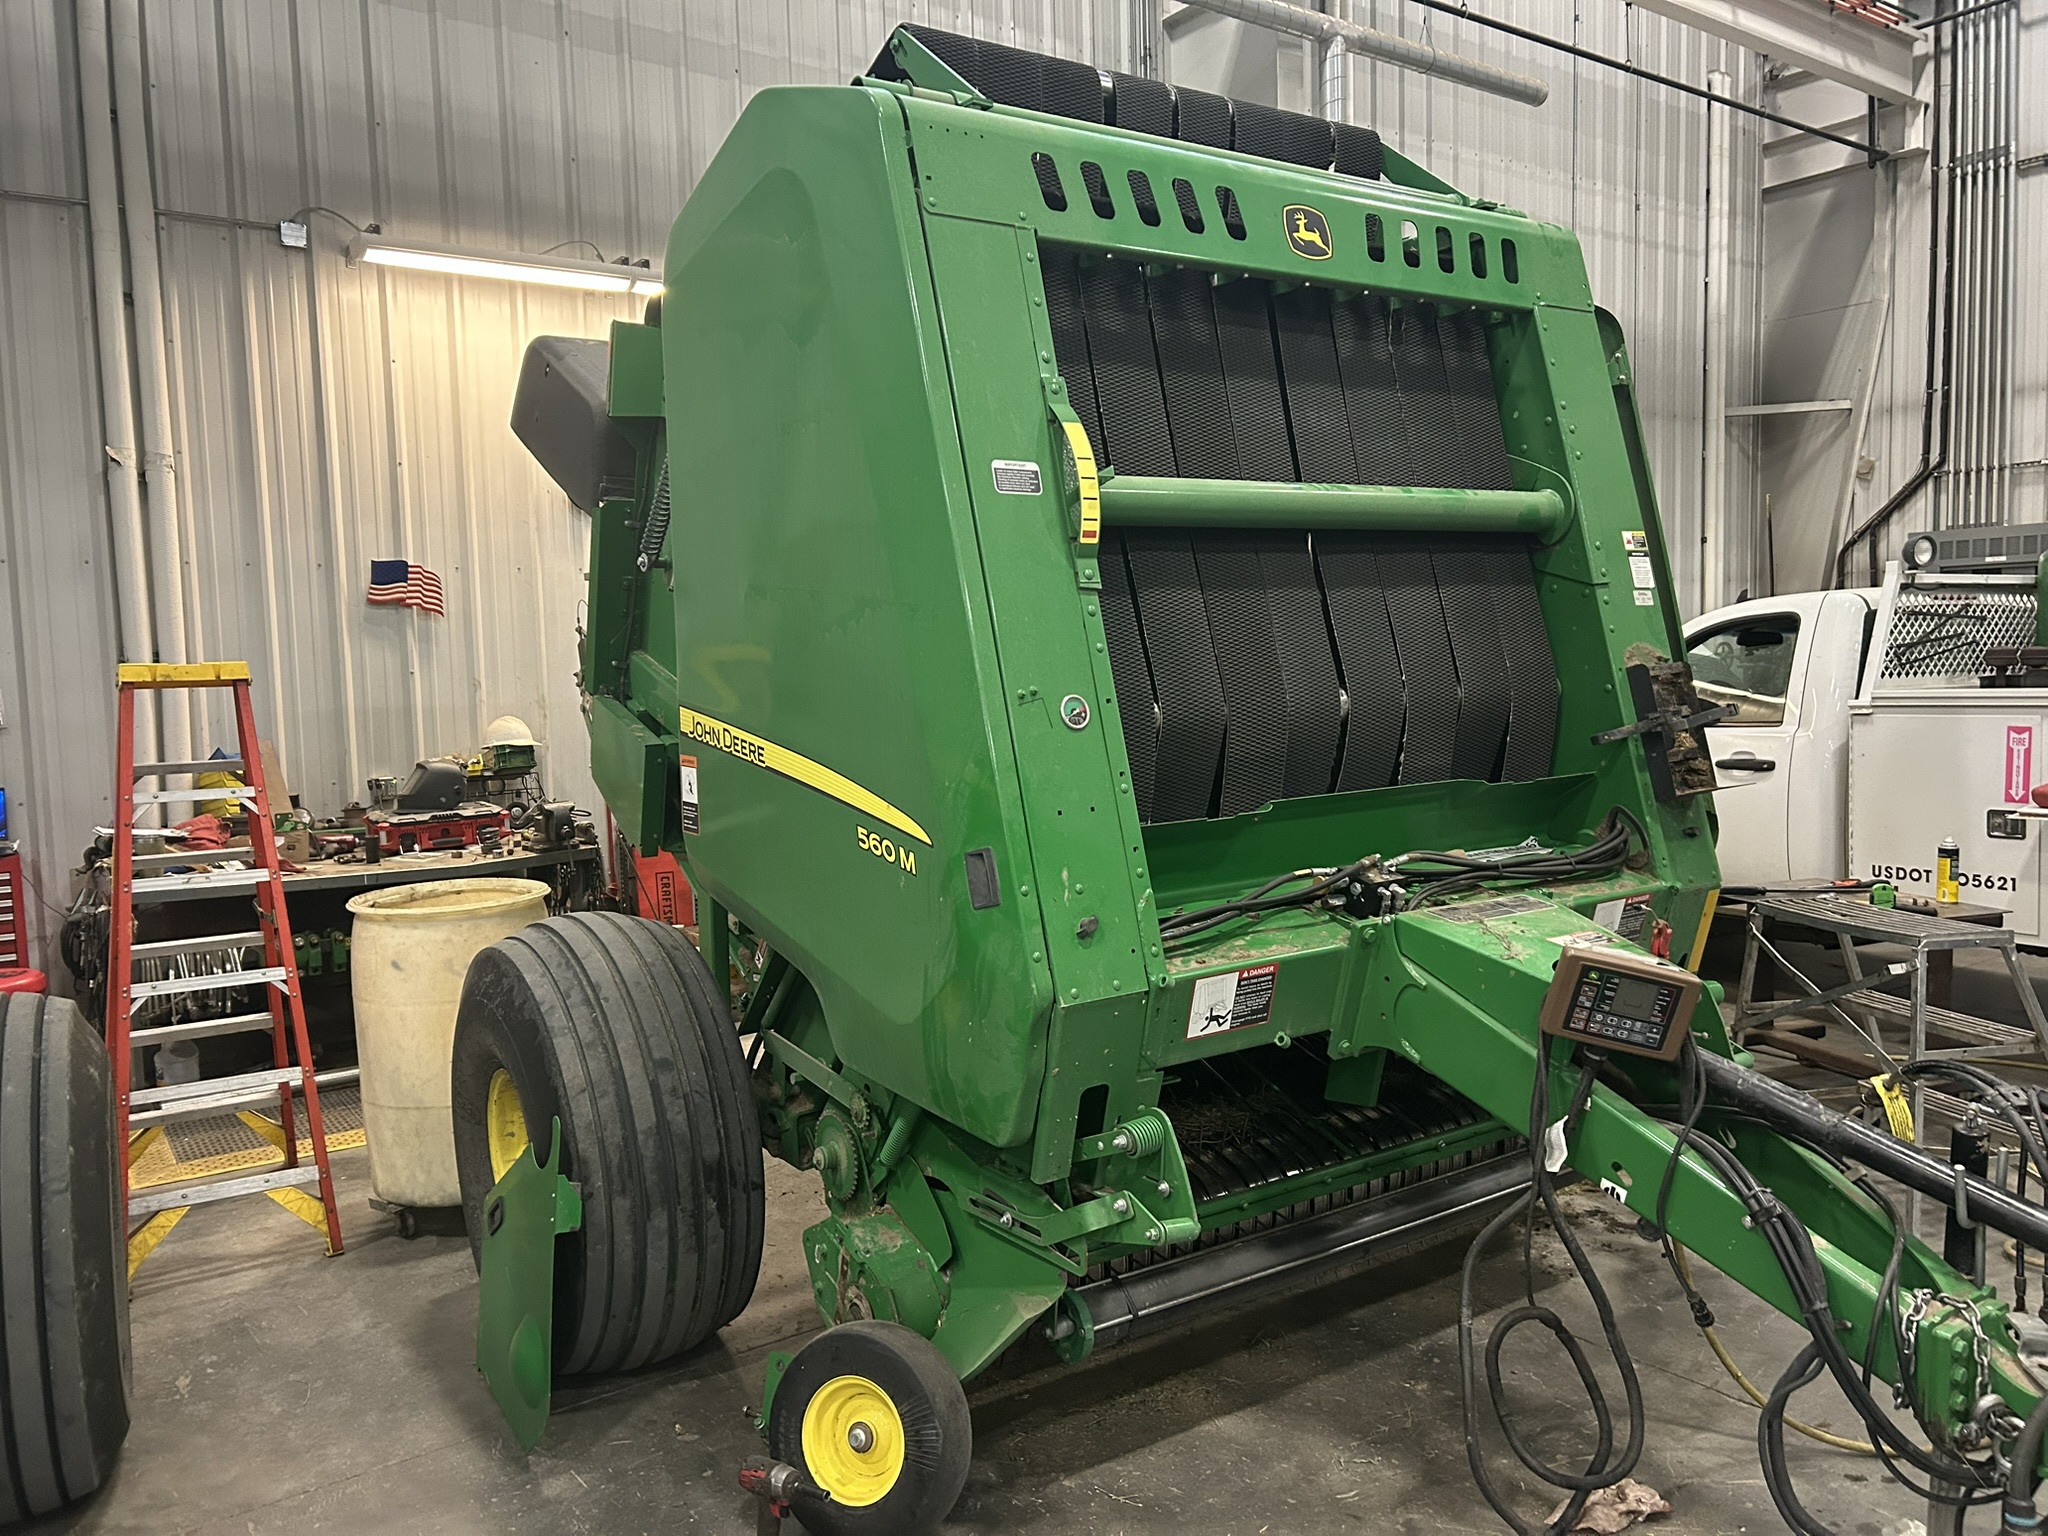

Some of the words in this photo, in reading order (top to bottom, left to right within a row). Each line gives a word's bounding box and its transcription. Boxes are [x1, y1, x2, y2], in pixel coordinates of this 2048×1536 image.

[689, 715, 720, 746] JOHN
[723, 727, 766, 764] DEERE
[2012, 737, 2027, 747] FIRE
[856, 824, 897, 864] 560
[898, 845, 917, 877] M
[1872, 864, 1933, 883] USDOT
[1249, 966, 1274, 976] DANGER
